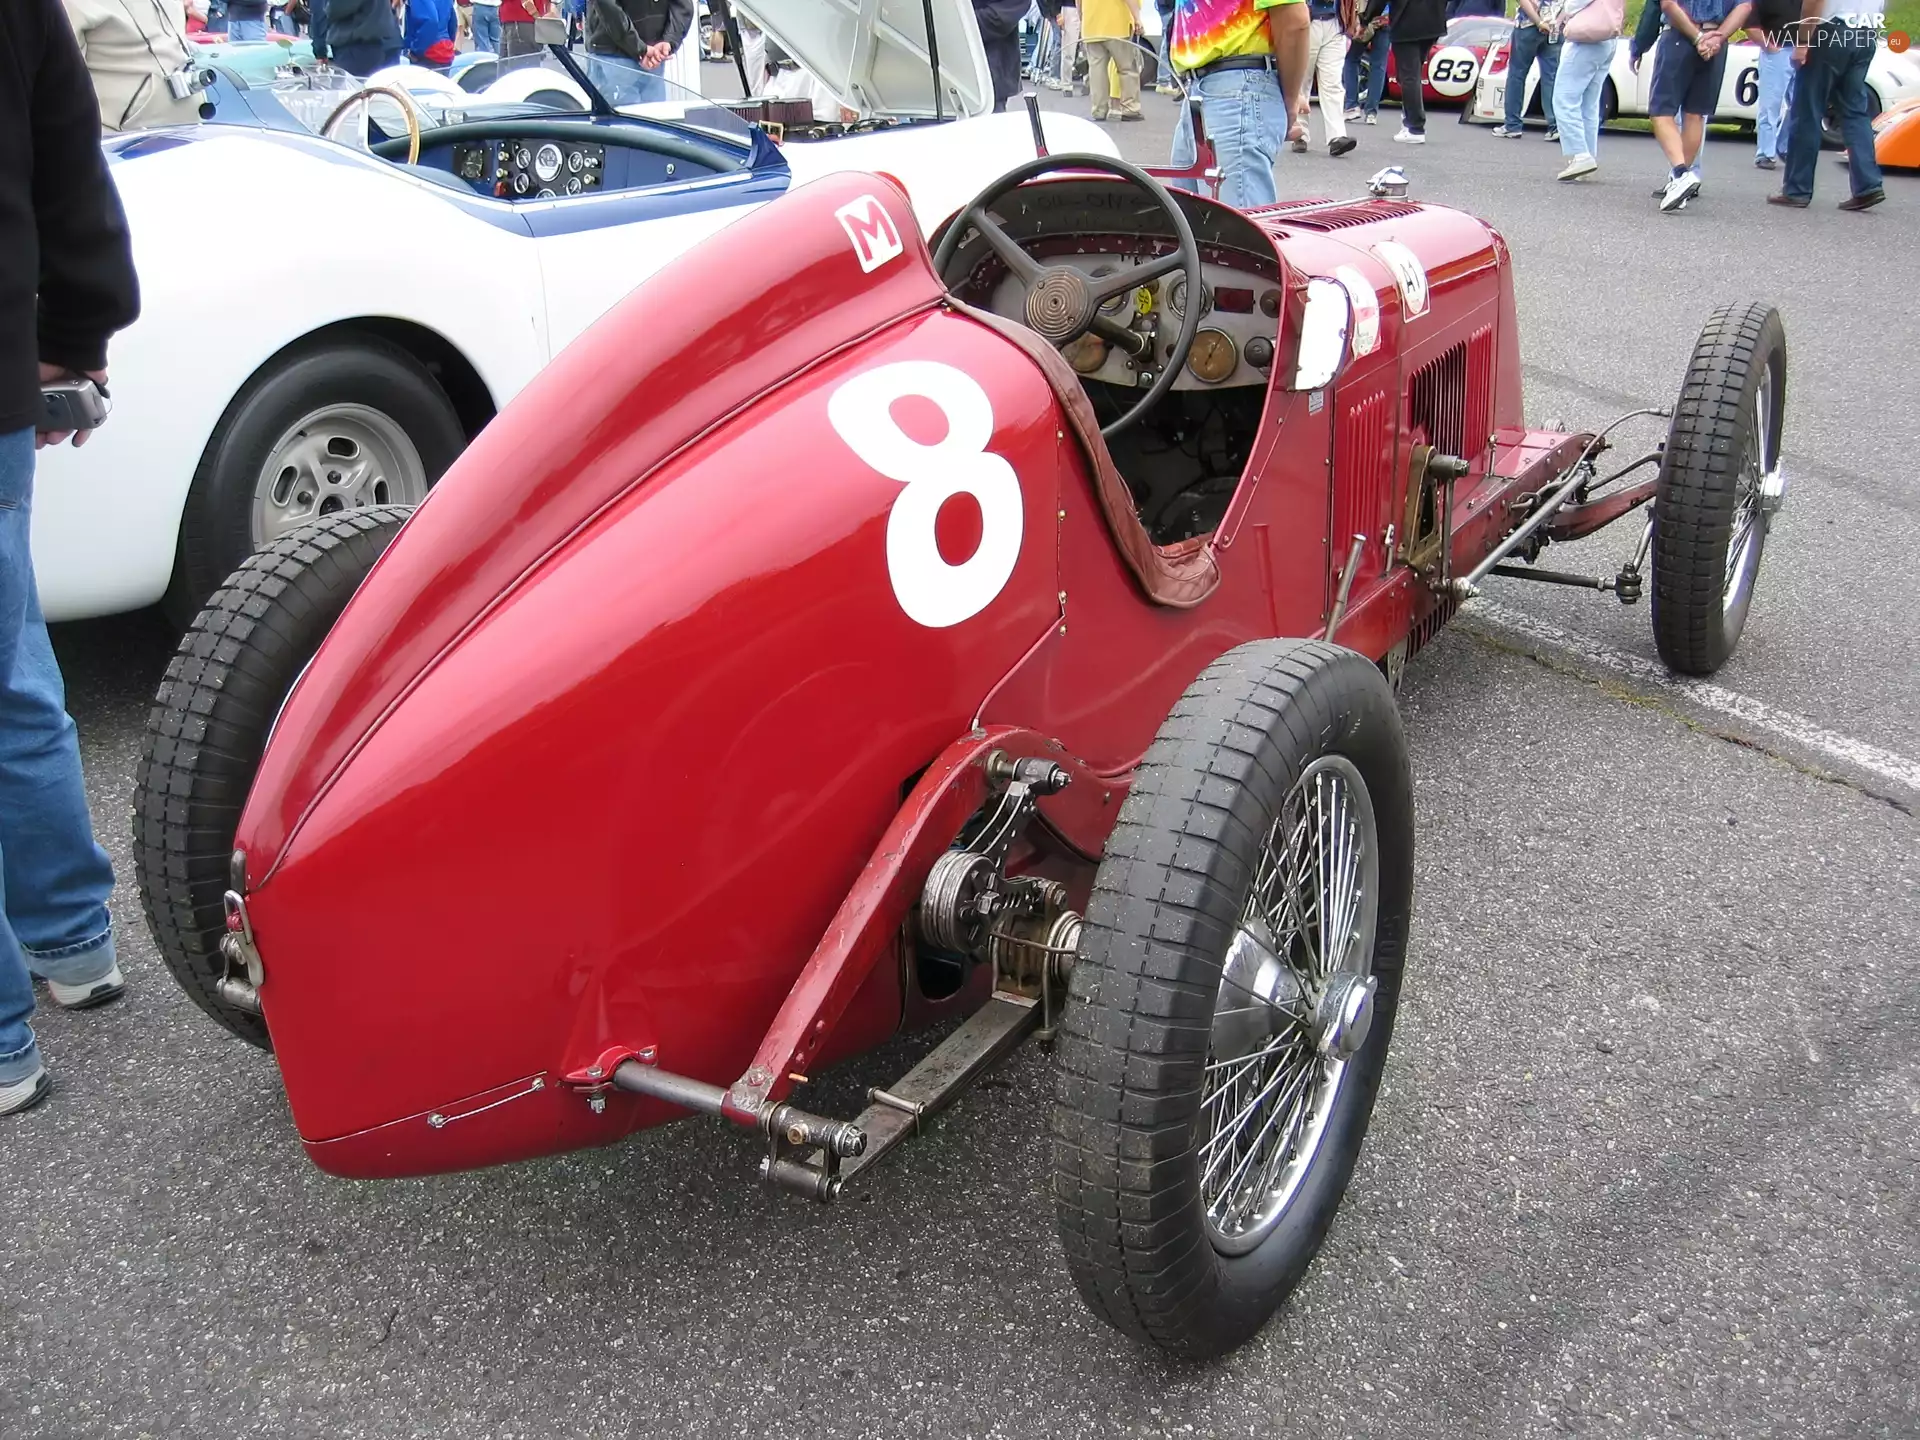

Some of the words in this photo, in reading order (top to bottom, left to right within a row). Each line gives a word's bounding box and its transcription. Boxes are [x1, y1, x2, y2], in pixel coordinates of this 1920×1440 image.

[1433, 59, 1475, 82] 83
[1735, 67, 1759, 106] 6
[844, 201, 897, 262] M
[828, 361, 1023, 627] 8
